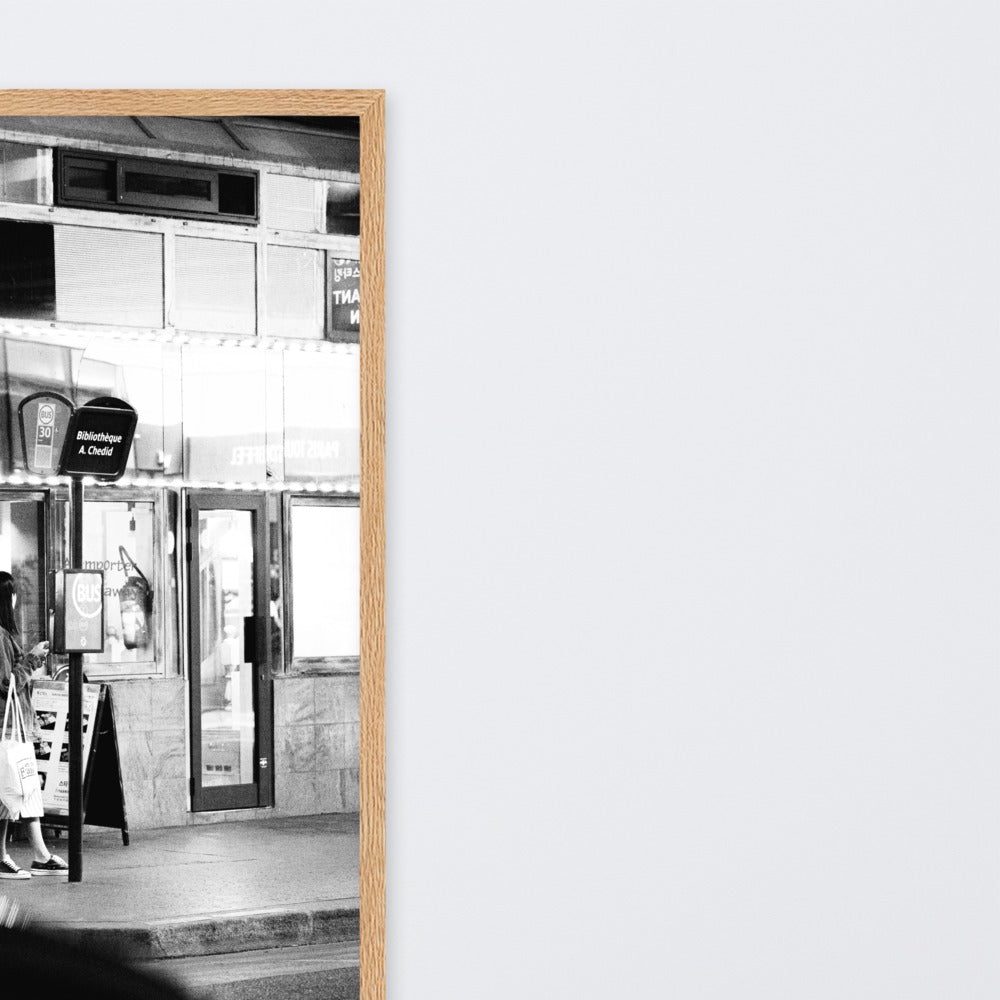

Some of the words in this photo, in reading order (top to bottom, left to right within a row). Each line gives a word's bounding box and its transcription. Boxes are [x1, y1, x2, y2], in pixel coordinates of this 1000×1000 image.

[38, 426, 51, 438] 30
[76, 430, 123, 444] Bibliothèque
[78, 444, 87, 455] A.
[87, 445, 114, 457] Chedid
[76, 583, 102, 603] BUS
